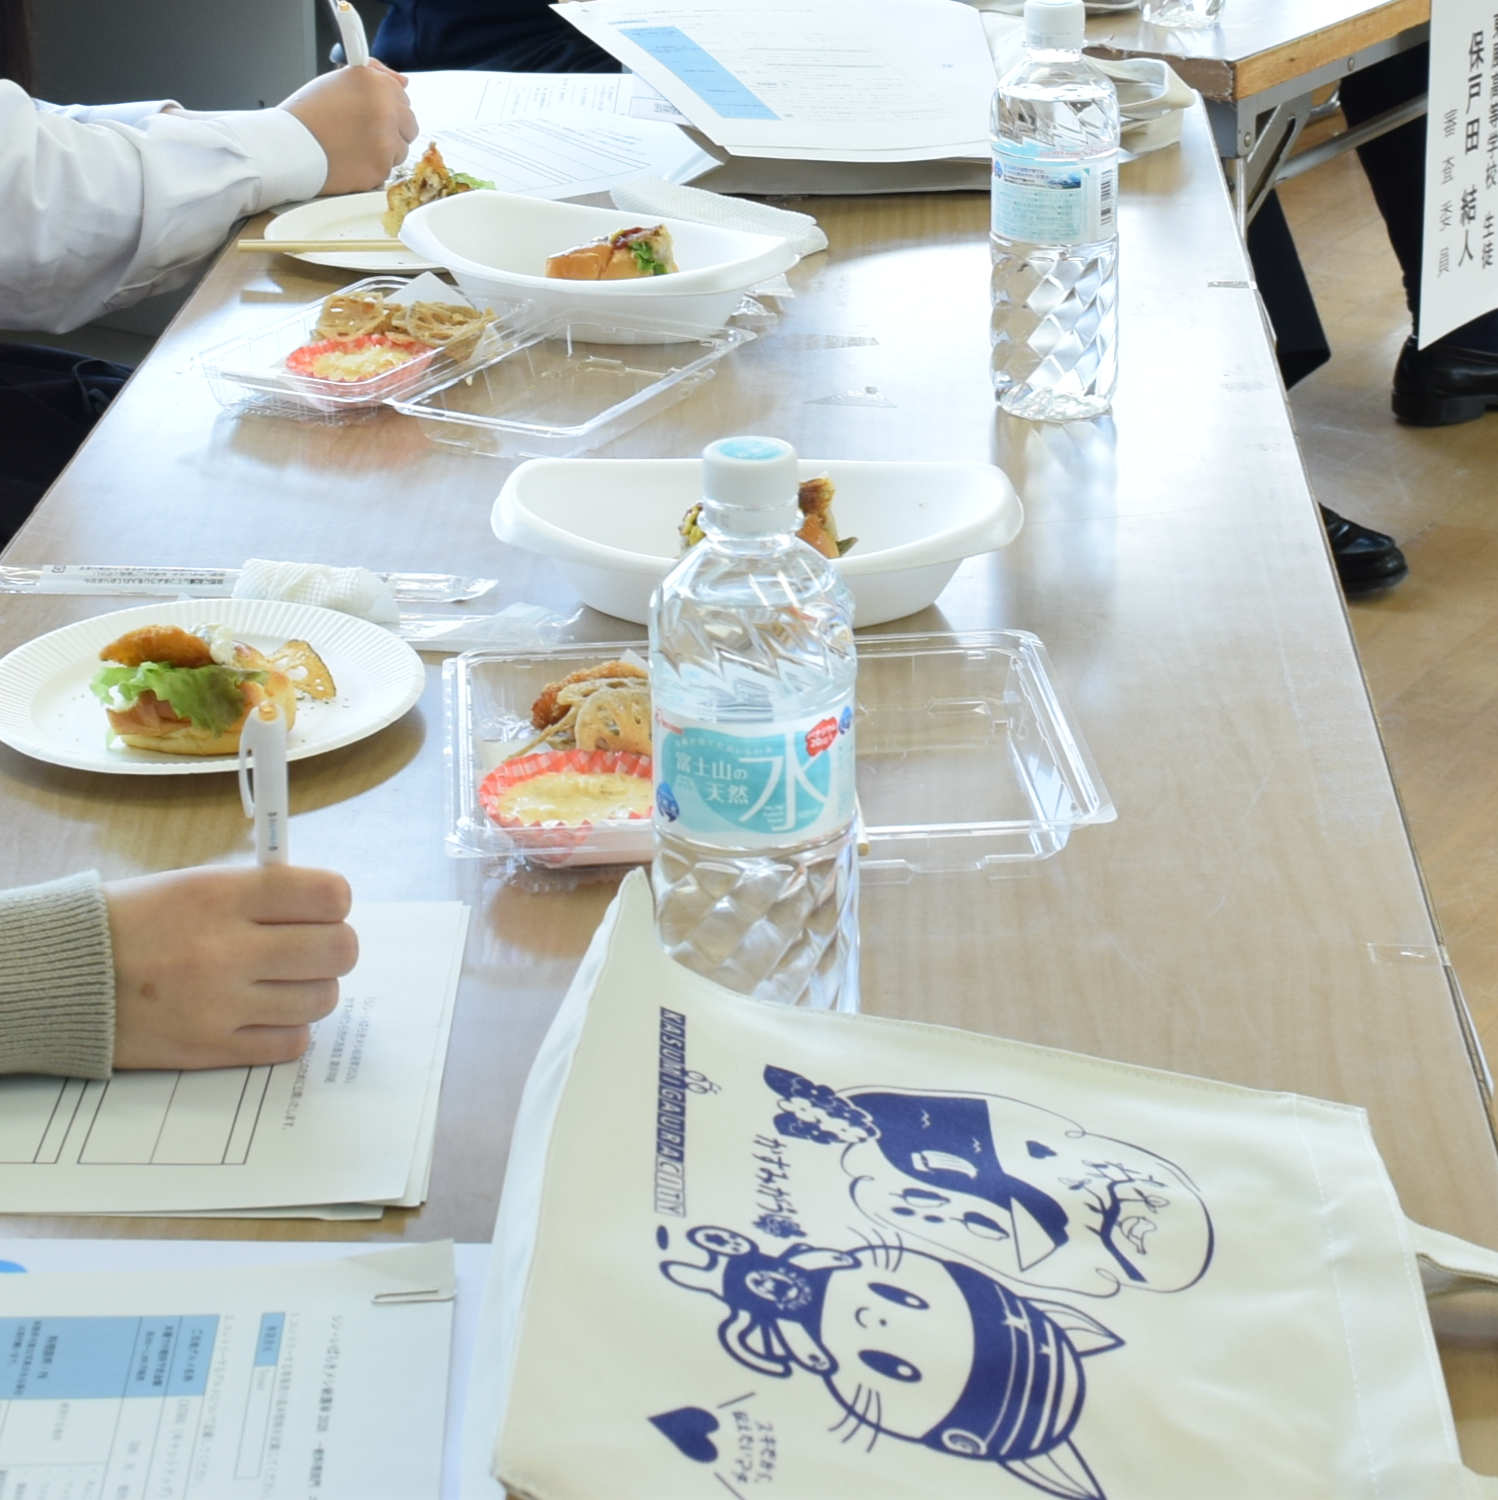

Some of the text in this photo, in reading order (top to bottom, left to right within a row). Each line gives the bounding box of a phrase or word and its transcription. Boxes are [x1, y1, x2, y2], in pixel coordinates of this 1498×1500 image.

[1465, 30, 1485, 155] 保戸田
[1438, 108, 1458, 278] 審査委員
[1481, 211, 1495, 269] 生徒
[675, 752, 748, 781] 富士山の
[705, 781, 749, 804] 天然
[739, 732, 831, 832] 水
[655, 1007, 686, 1217] KASUMIGAURA CITY
